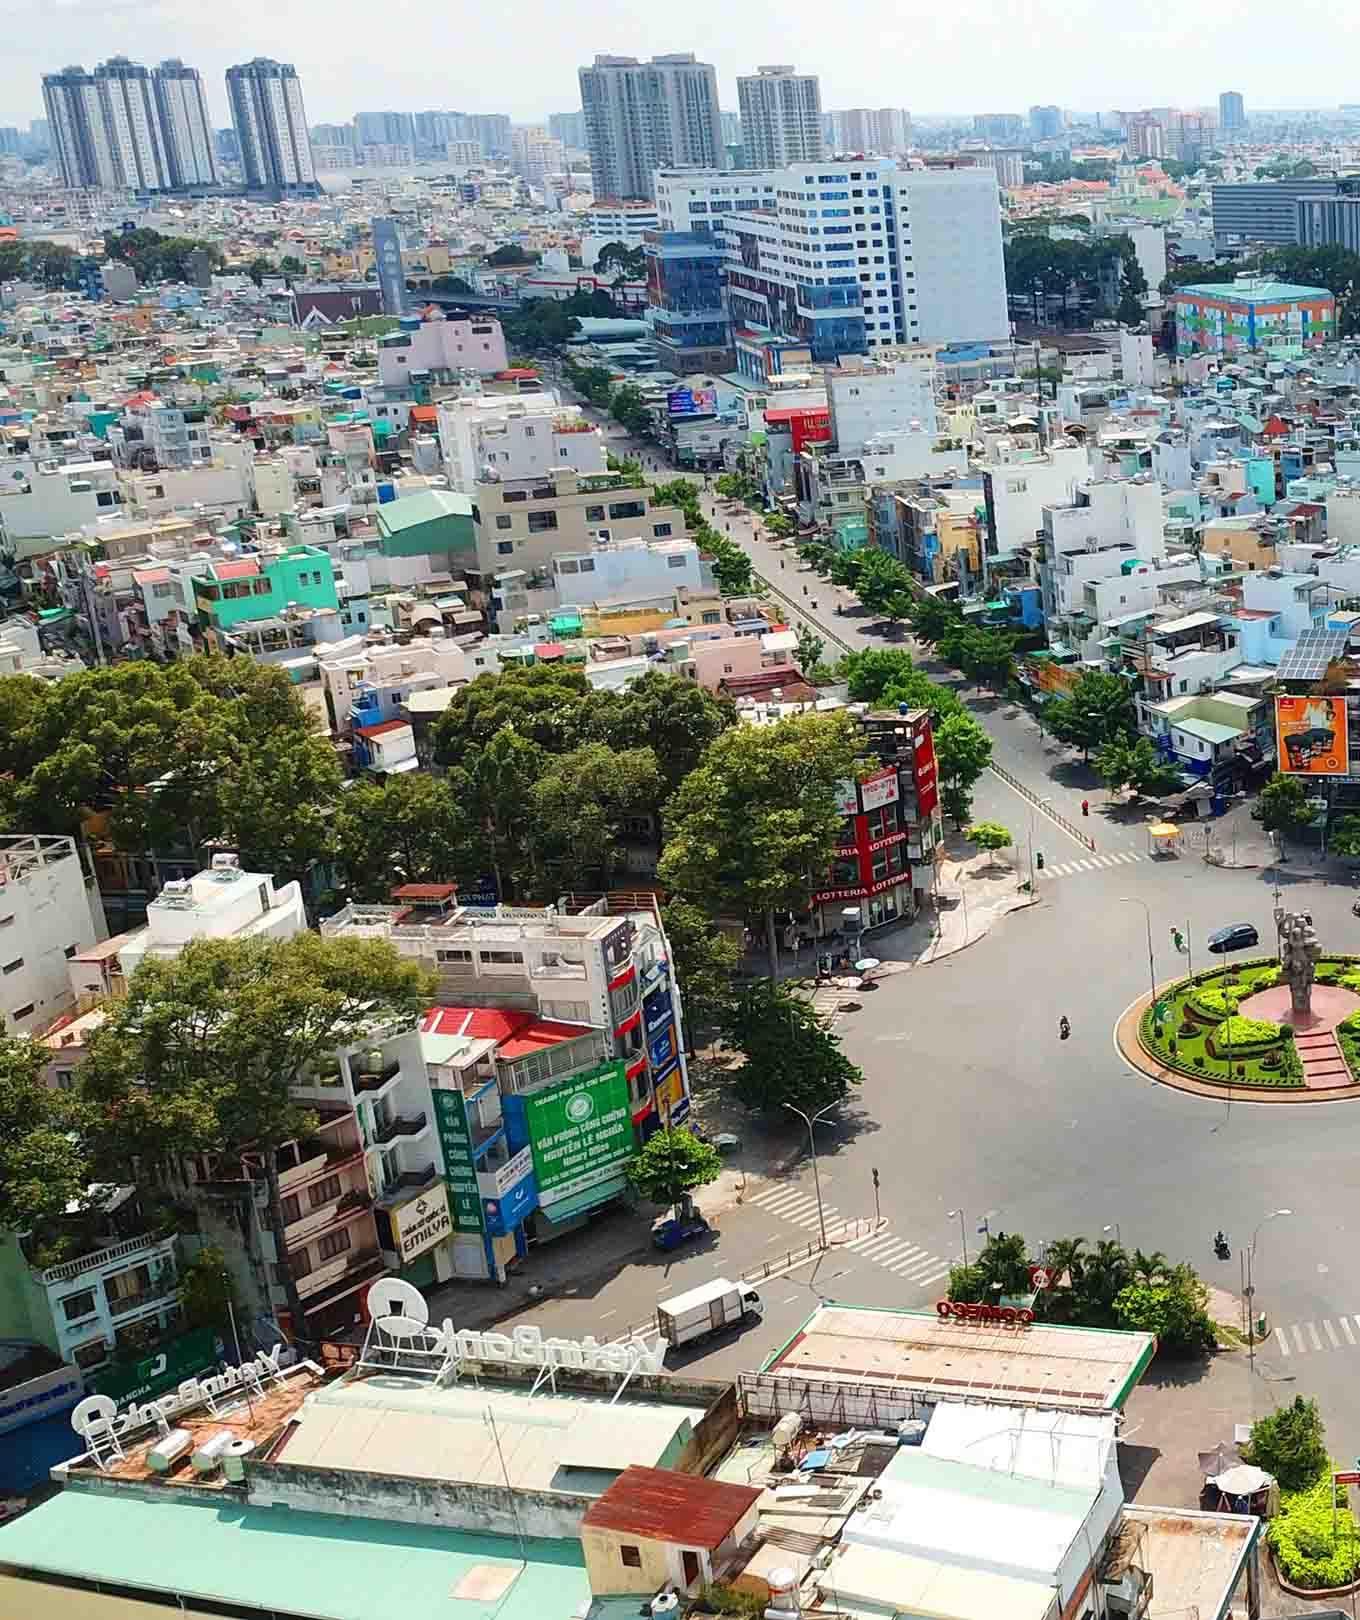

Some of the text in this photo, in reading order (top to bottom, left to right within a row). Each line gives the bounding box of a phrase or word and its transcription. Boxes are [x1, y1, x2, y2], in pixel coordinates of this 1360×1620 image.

[869, 832, 907, 852] LOTTERIA
[871, 872, 909, 892] LOTTERIA
[816, 887, 868, 901] LOTTERIA
